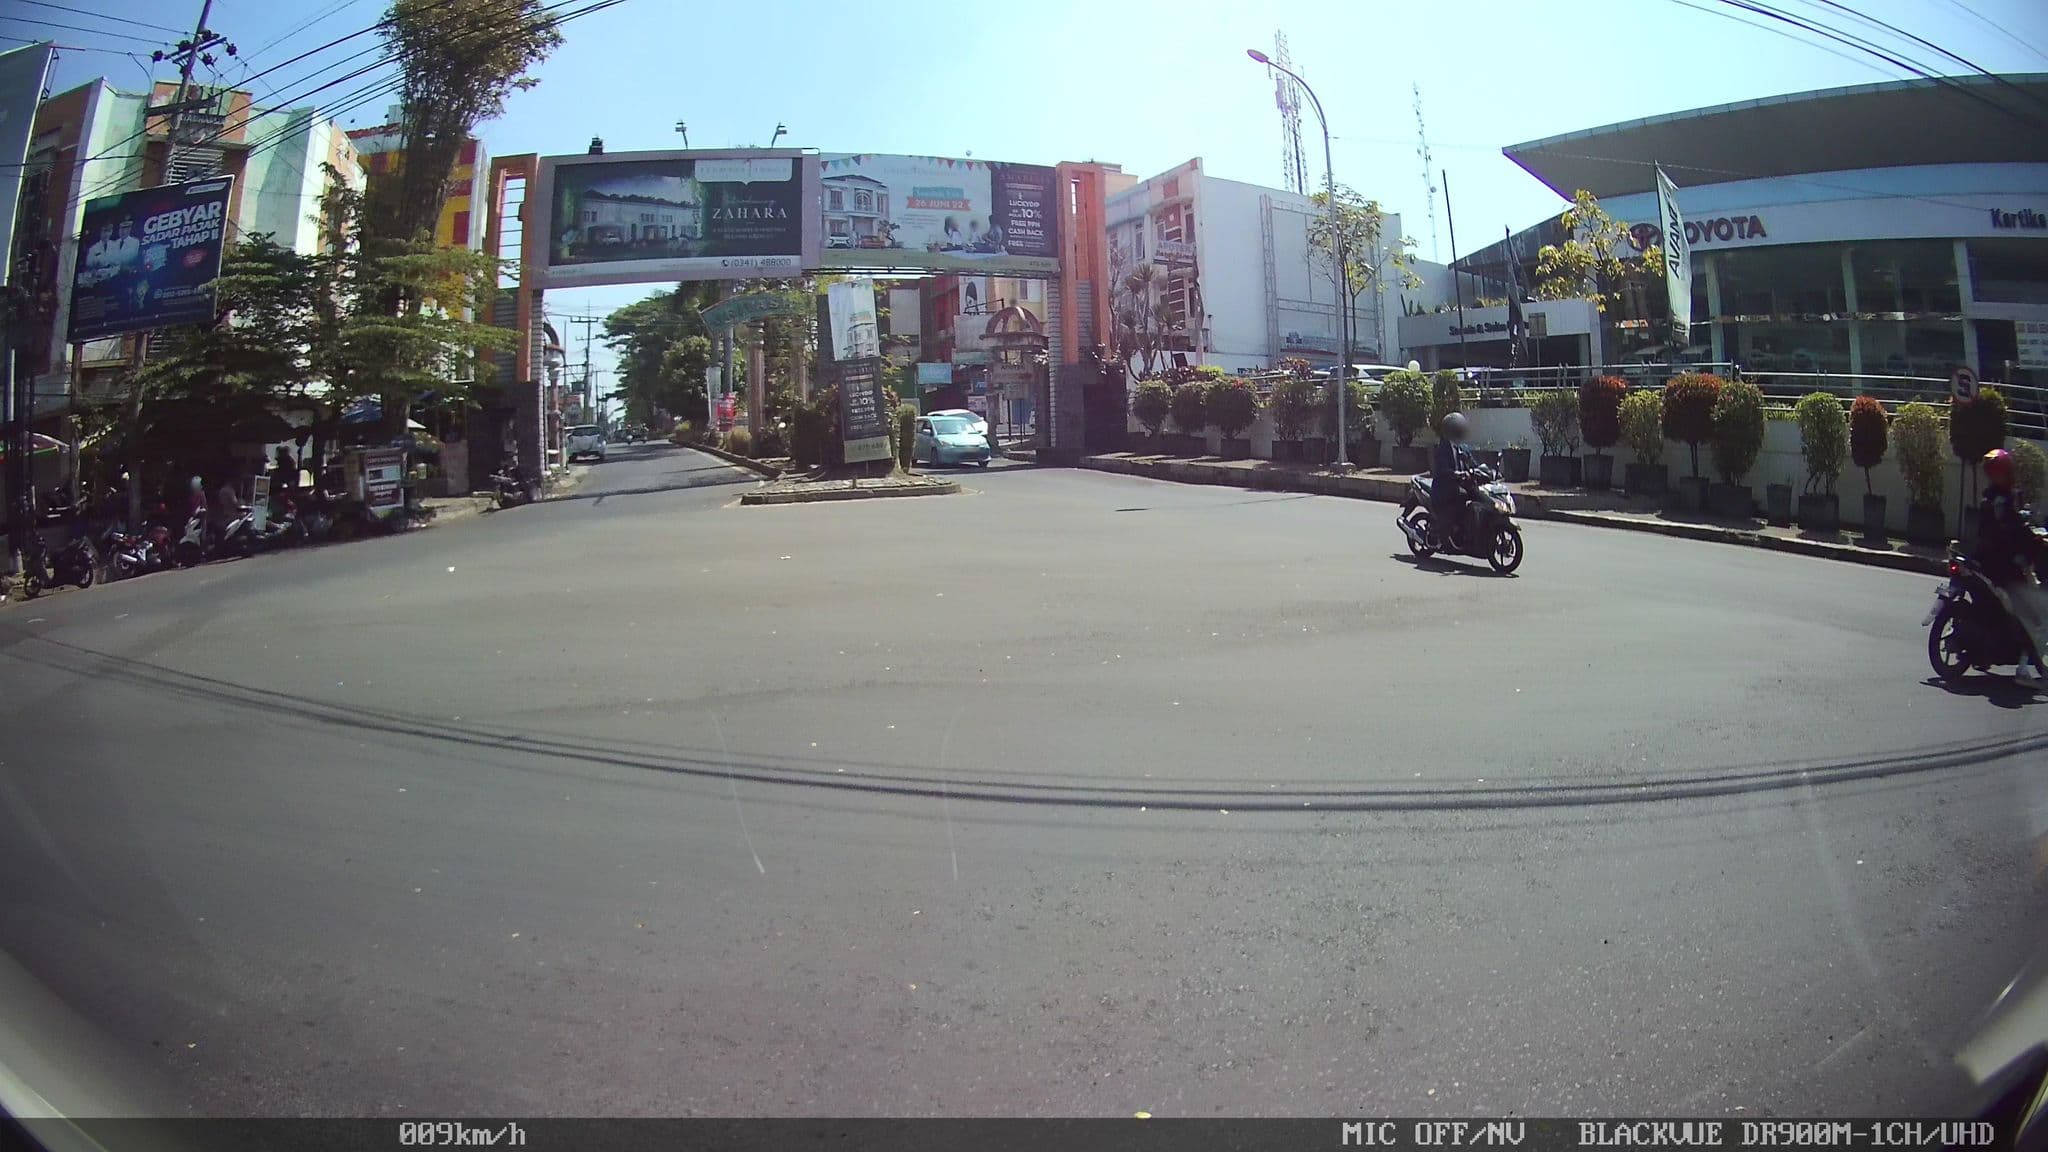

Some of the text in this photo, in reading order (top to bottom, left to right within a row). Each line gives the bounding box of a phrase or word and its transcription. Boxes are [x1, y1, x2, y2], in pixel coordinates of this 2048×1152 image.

[143, 201, 222, 234] GEBYAR
[713, 207, 787, 219] ZAHARA
[1990, 207, 2048, 230] Kartika
[141, 218, 220, 246] SADAR PAJAK
[171, 230, 210, 248] TAHAP
[1684, 215, 1767, 244] OYOTA
[731, 259, 758, 267] (0341)
